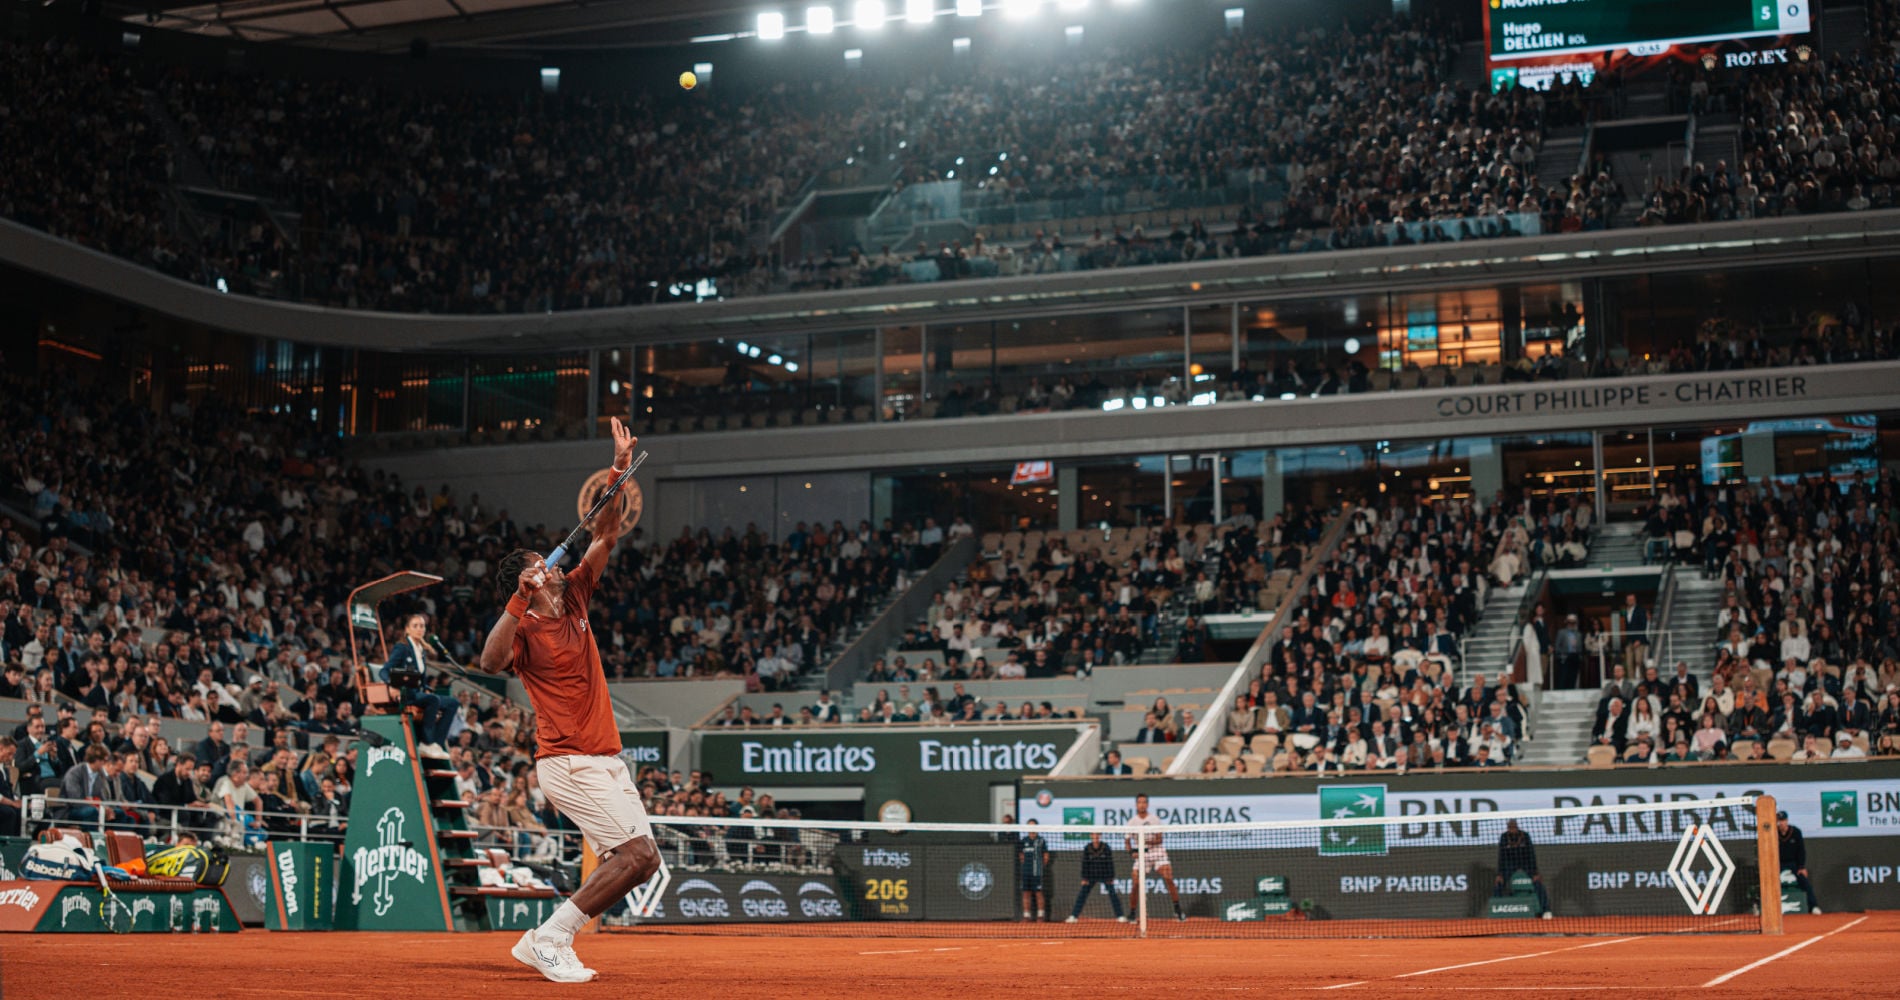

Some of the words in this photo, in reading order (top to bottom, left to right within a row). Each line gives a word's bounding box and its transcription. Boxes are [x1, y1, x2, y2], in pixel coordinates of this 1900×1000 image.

[1761, 5, 1771, 20] 5
[1503, 22, 1541, 37] Hugo
[1504, 32, 1564, 51] DELLIEN
[1437, 393, 1525, 417] COURT
[1535, 385, 1650, 411] PHILIPPE
[1675, 376, 1807, 402] CHATRIER
[742, 740, 876, 773] Emirates
[919, 737, 1058, 772] Emirates
[1399, 798, 1498, 840] BNP
[1553, 789, 1765, 836] PARIBAS
[278, 849, 298, 917] Wilson
[1340, 876, 1382, 893] BNP
[1385, 875, 1468, 892] PARIBAS
[1588, 872, 1630, 890] BNP
[1848, 866, 1891, 885] BNP
[865, 879, 908, 901] 206
